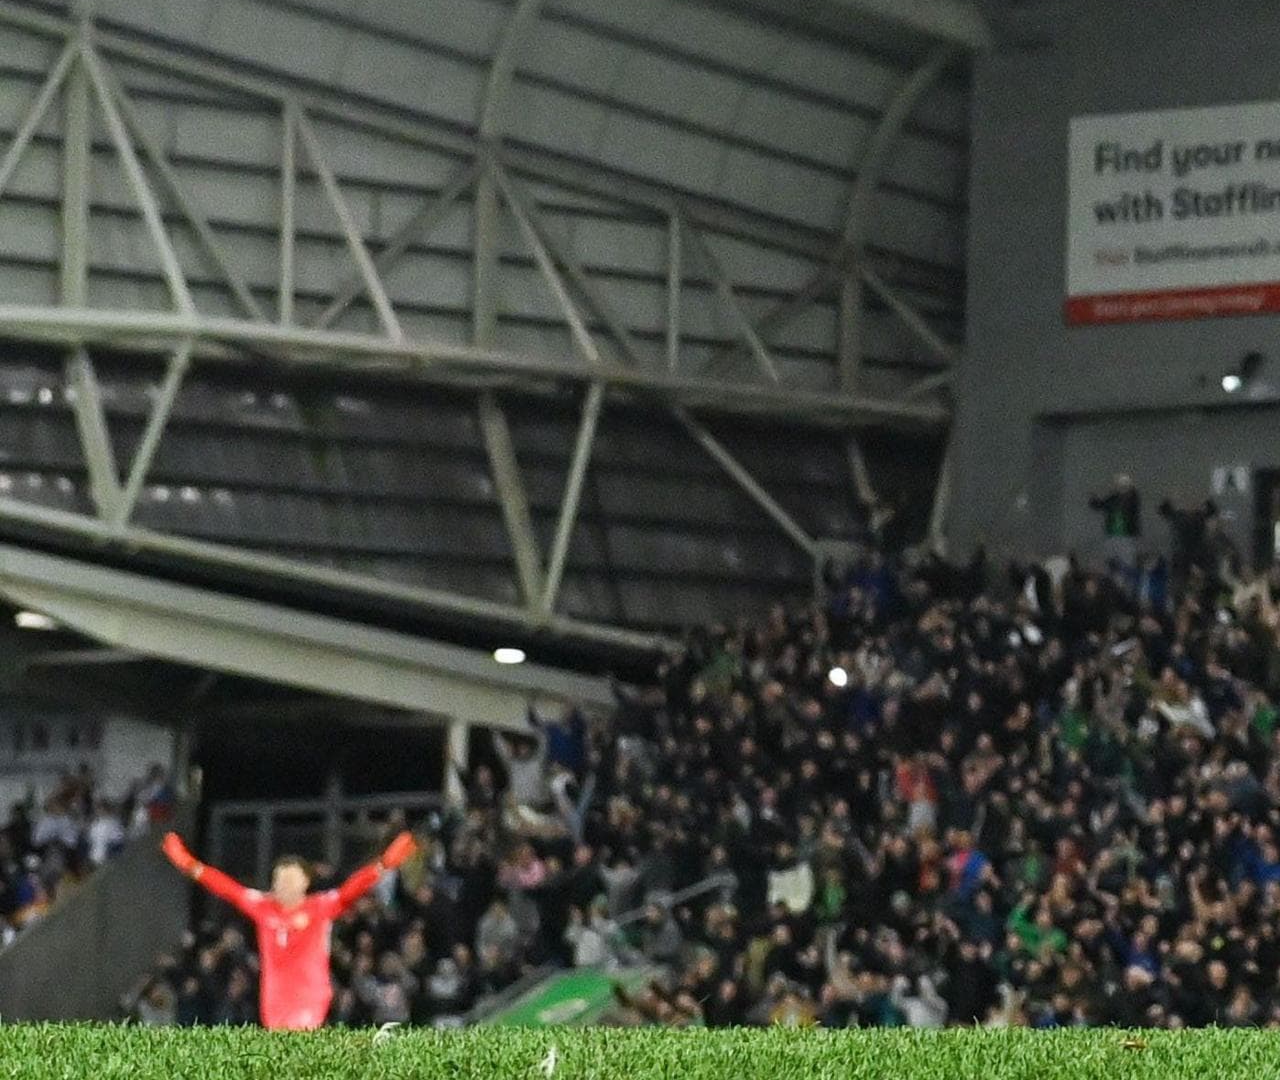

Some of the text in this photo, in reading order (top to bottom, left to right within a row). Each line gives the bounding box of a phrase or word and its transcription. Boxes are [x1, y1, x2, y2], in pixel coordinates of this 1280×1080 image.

[1095, 140, 1162, 172] Find
[1172, 140, 1245, 177] your
[1094, 190, 1163, 223] with
